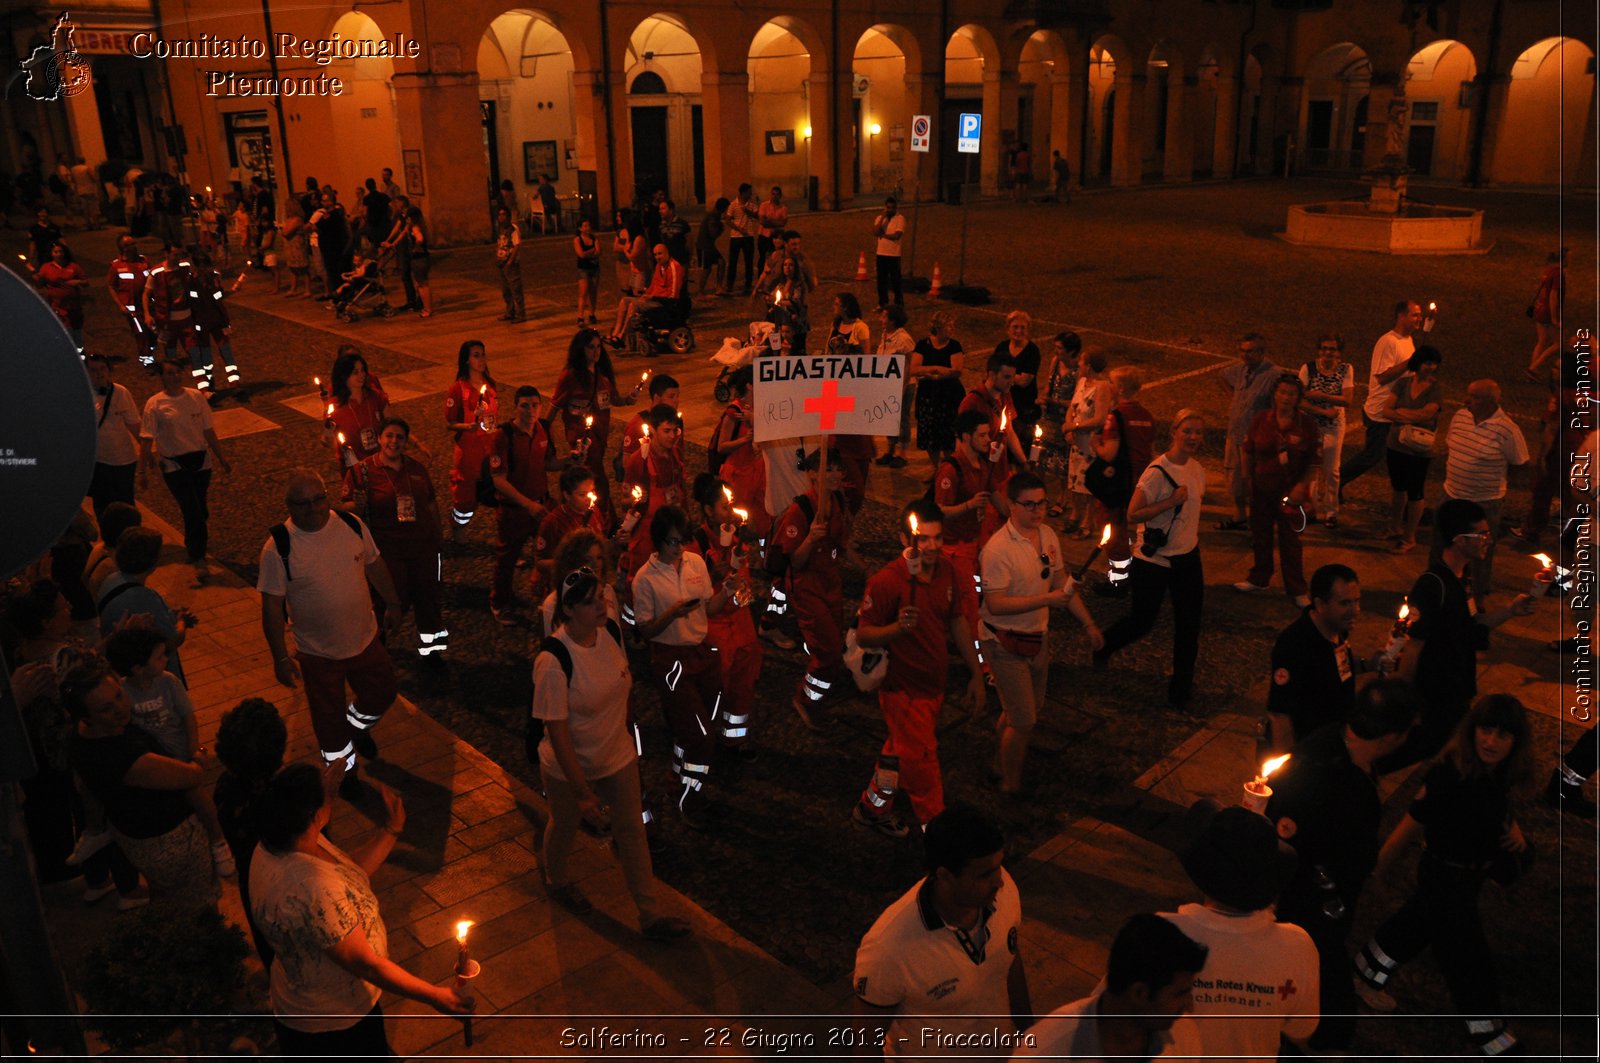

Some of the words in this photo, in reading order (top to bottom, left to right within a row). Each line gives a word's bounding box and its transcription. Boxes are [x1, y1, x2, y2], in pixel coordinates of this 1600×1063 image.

[963, 116, 978, 137] P
[759, 357, 901, 382] GUASTALLA
[763, 398, 794, 425] (RE)
[863, 395, 901, 424] 2013
[1216, 979, 1243, 991] Rotes
[1246, 982, 1275, 994] Kreuz
